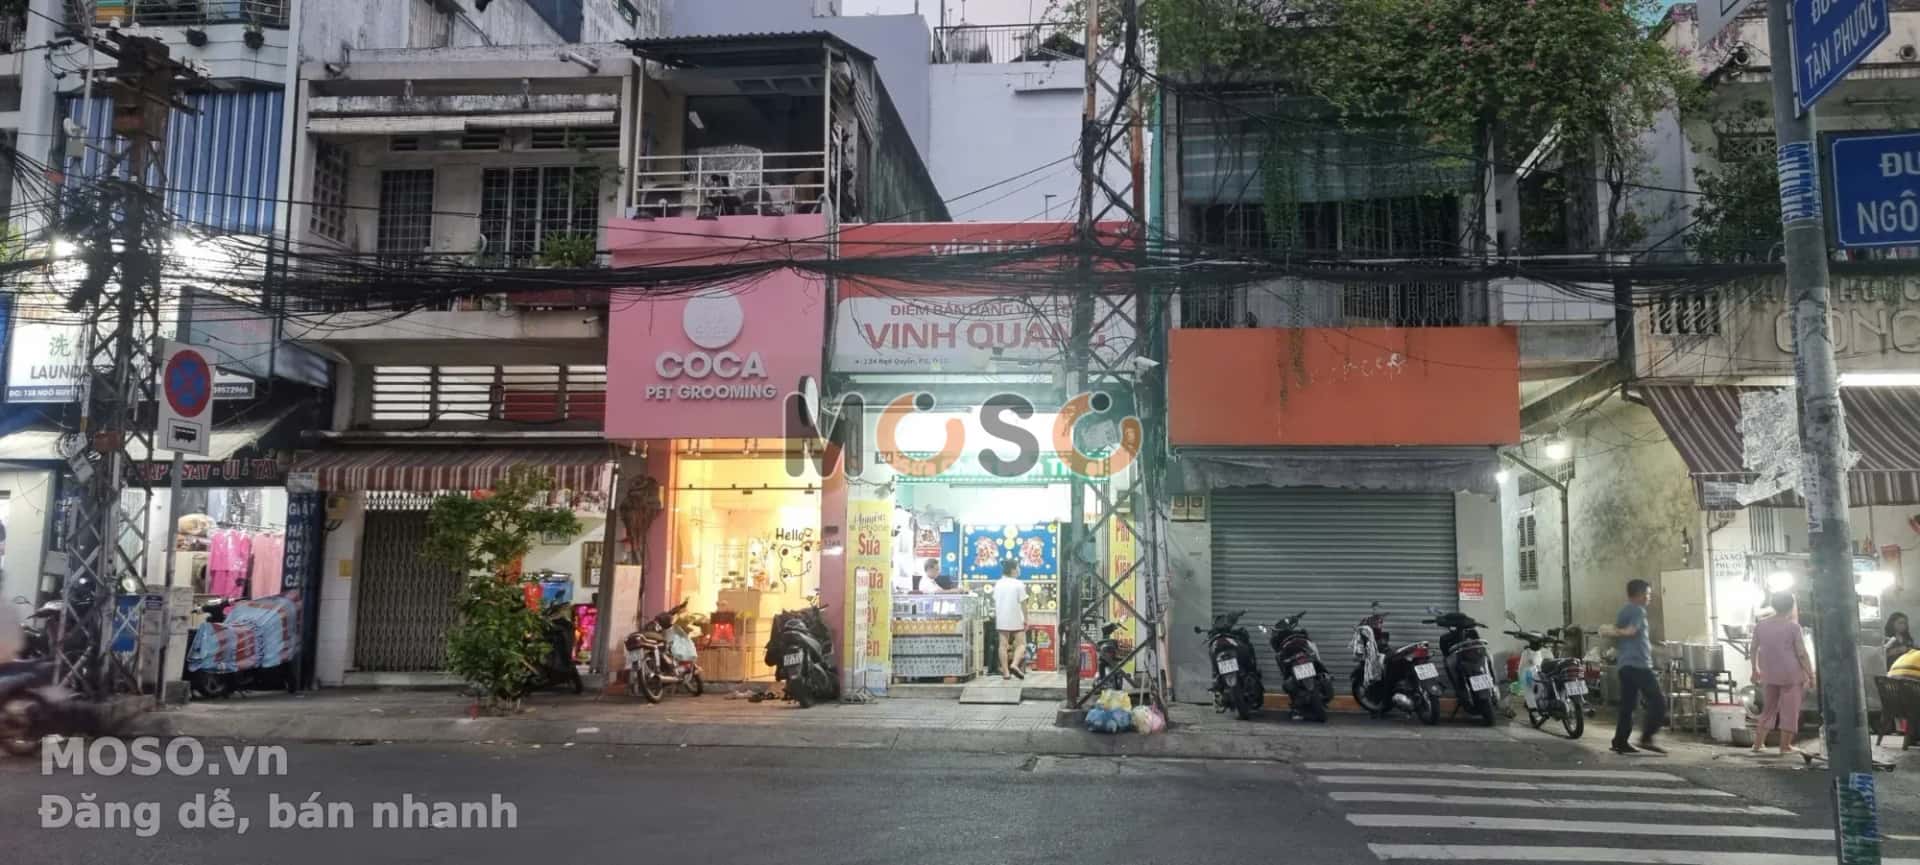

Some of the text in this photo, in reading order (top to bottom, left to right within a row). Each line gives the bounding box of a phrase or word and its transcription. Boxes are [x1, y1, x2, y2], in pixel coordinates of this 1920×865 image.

[1857, 189, 1918, 235] NGÔ
[864, 322, 956, 349] VINH
[656, 351, 768, 379] COCA
[646, 384, 777, 399] PET GROOMING
[776, 527, 805, 541] Hello
